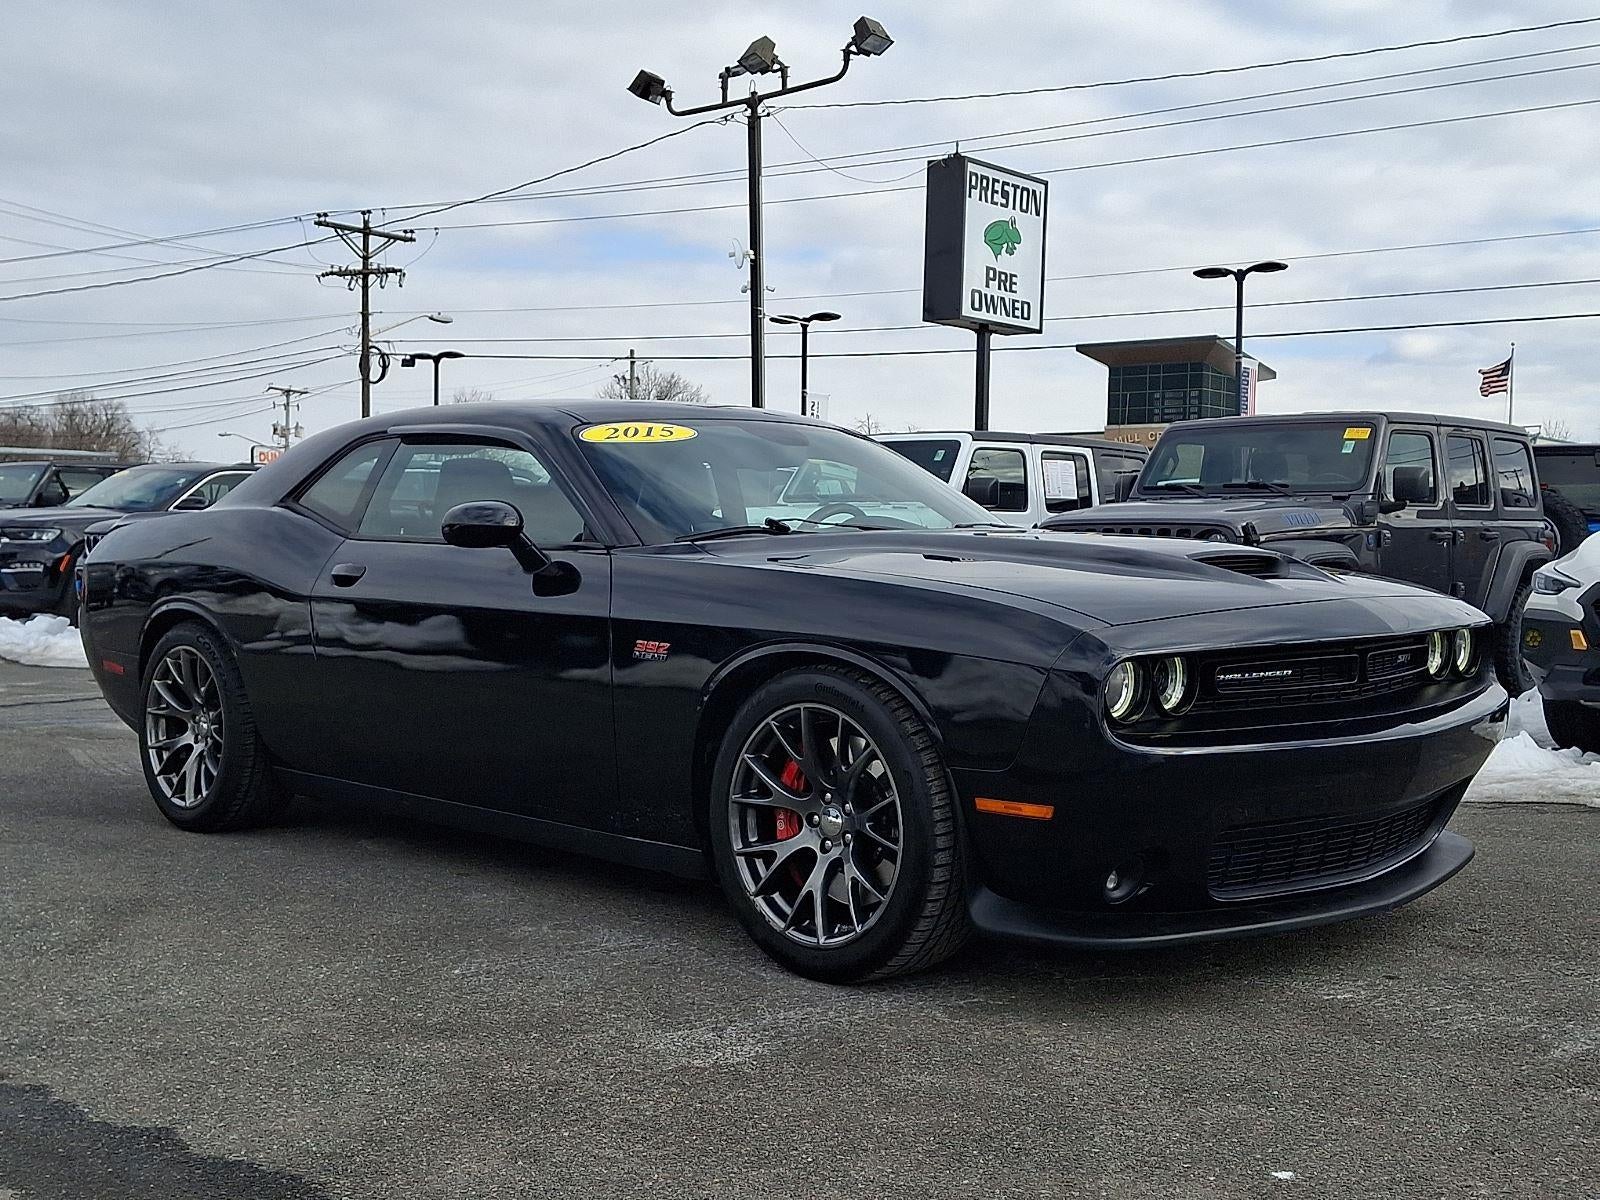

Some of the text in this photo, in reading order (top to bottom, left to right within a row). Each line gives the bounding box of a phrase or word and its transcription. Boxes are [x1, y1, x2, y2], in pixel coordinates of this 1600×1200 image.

[967, 170, 1042, 217] PRESTON
[984, 265, 1018, 294] PRE
[970, 288, 1031, 321] OWNED
[604, 426, 674, 440] 2015
[634, 640, 670, 654] 392
